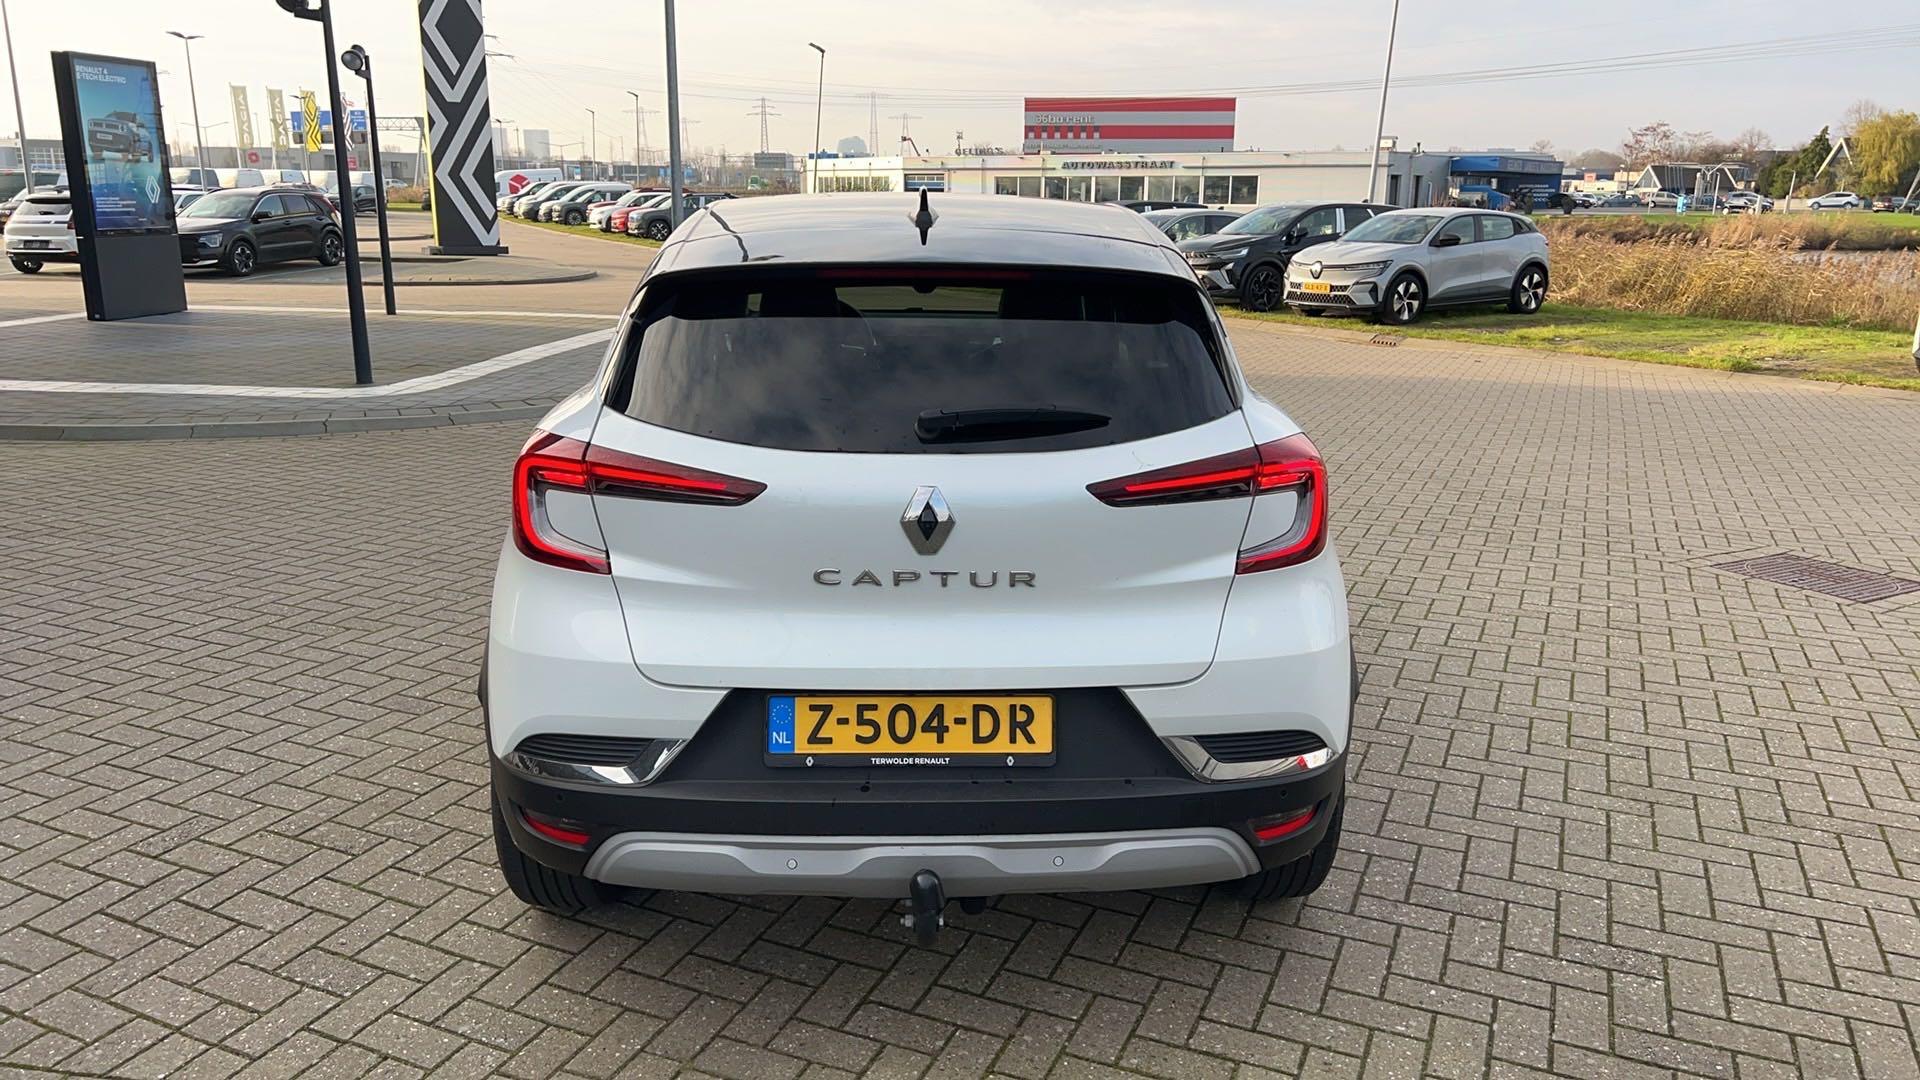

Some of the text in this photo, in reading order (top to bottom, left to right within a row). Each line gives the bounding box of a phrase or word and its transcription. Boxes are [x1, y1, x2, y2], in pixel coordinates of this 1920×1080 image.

[1061, 160, 1175, 170] AUTOWASSTRAAT
[813, 568, 1036, 588] CAPTUR
[807, 703, 1035, 745] Z-504-DR
[772, 731, 791, 744] NL
[871, 757, 950, 765] TERWOLDE RENAULT
